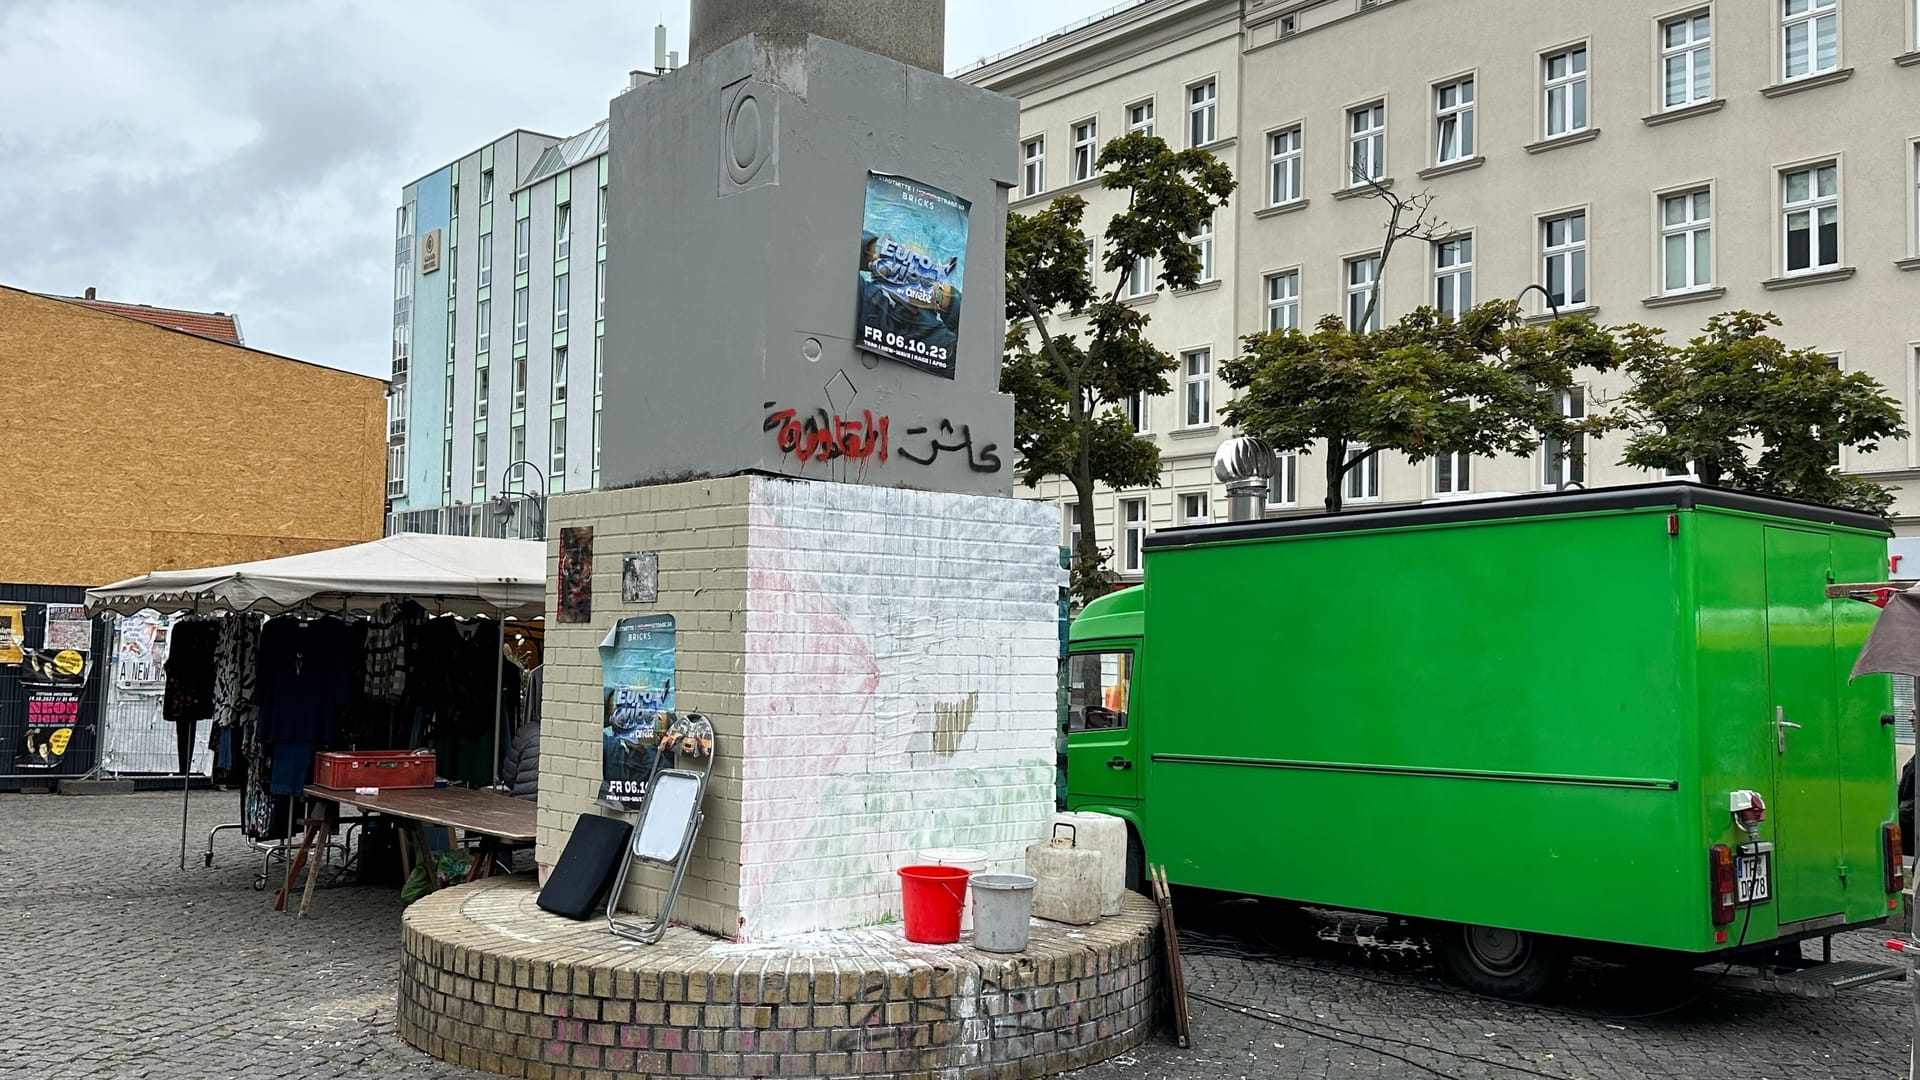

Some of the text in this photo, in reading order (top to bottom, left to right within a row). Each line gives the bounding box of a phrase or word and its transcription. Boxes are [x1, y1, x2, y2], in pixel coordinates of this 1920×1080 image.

[902, 192, 935, 210] BRICKS
[864, 325, 947, 360] FR 06.10.23
[627, 631, 652, 641] BRICKS
[119, 661, 126, 680] A
[131, 661, 150, 680] NEW
[29, 701, 78, 714] NEON
[29, 714, 76, 723] NIGHTS
[609, 781, 623, 793] FR
[1754, 877, 1766, 896] 78
